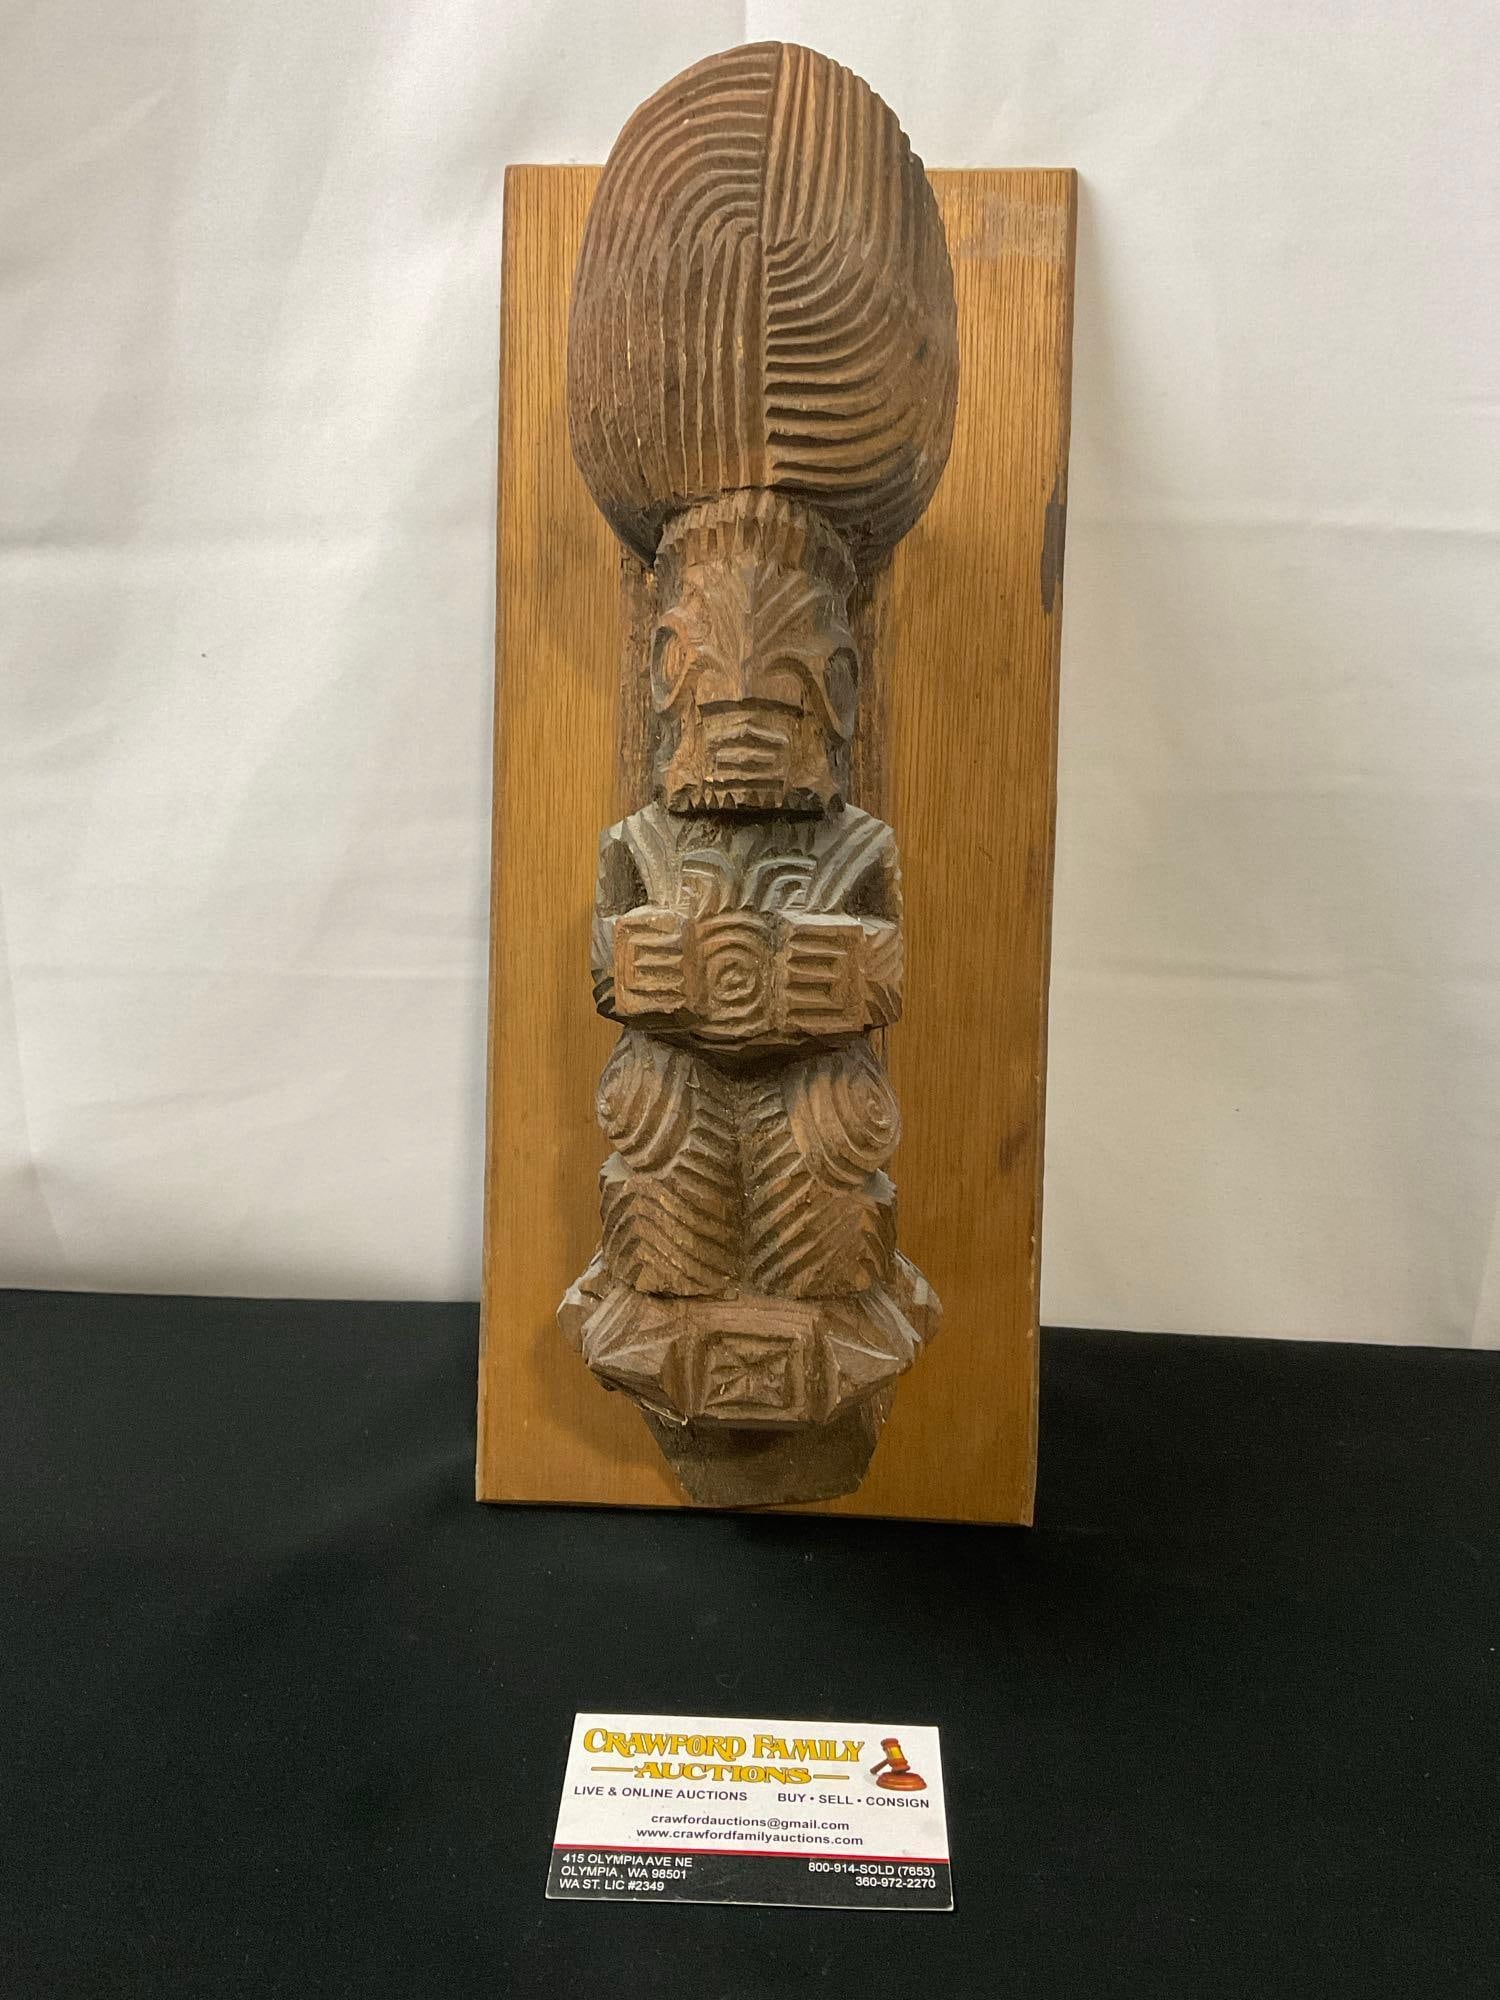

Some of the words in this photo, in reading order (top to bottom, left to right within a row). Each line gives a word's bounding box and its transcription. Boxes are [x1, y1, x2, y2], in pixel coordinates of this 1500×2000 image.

[583, 1728, 747, 1762] CRAWFORD
[752, 1734, 865, 1762] FAMILY
[633, 1761, 812, 1784] AUCTIONS
[574, 1786, 603, 1795] LIVE
[608, 1787, 617, 1796] &
[622, 1788, 673, 1798] ONLINE
[676, 1789, 747, 1801] AUCTIONS
[778, 1793, 806, 1802] BUY
[819, 1795, 853, 1804] SELL
[866, 1797, 929, 1808] CONSIGN
[651, 1814, 850, 1831] crawfordauctions@gmail.com
[636, 1828, 863, 1846] www.crawfordfamilyauctions.com
[562, 1854, 584, 1863] 415
[588, 1854, 643, 1865] OLYMPIA
[646, 1857, 671, 1867] AVE
[675, 1858, 692, 1867] NE
[628, 1869, 648, 1878] WA
[652, 1870, 687, 1879] 98501
[808, 1862, 894, 1876] 800-914-SOLD
[898, 1866, 935, 1876] (7653)
[559, 1879, 579, 1888] WA
[582, 1879, 600, 1889] ST.
[605, 1880, 624, 1889] LIC
[628, 1881, 665, 1891] #2349
[855, 1877, 936, 1888] 360-972-2270
